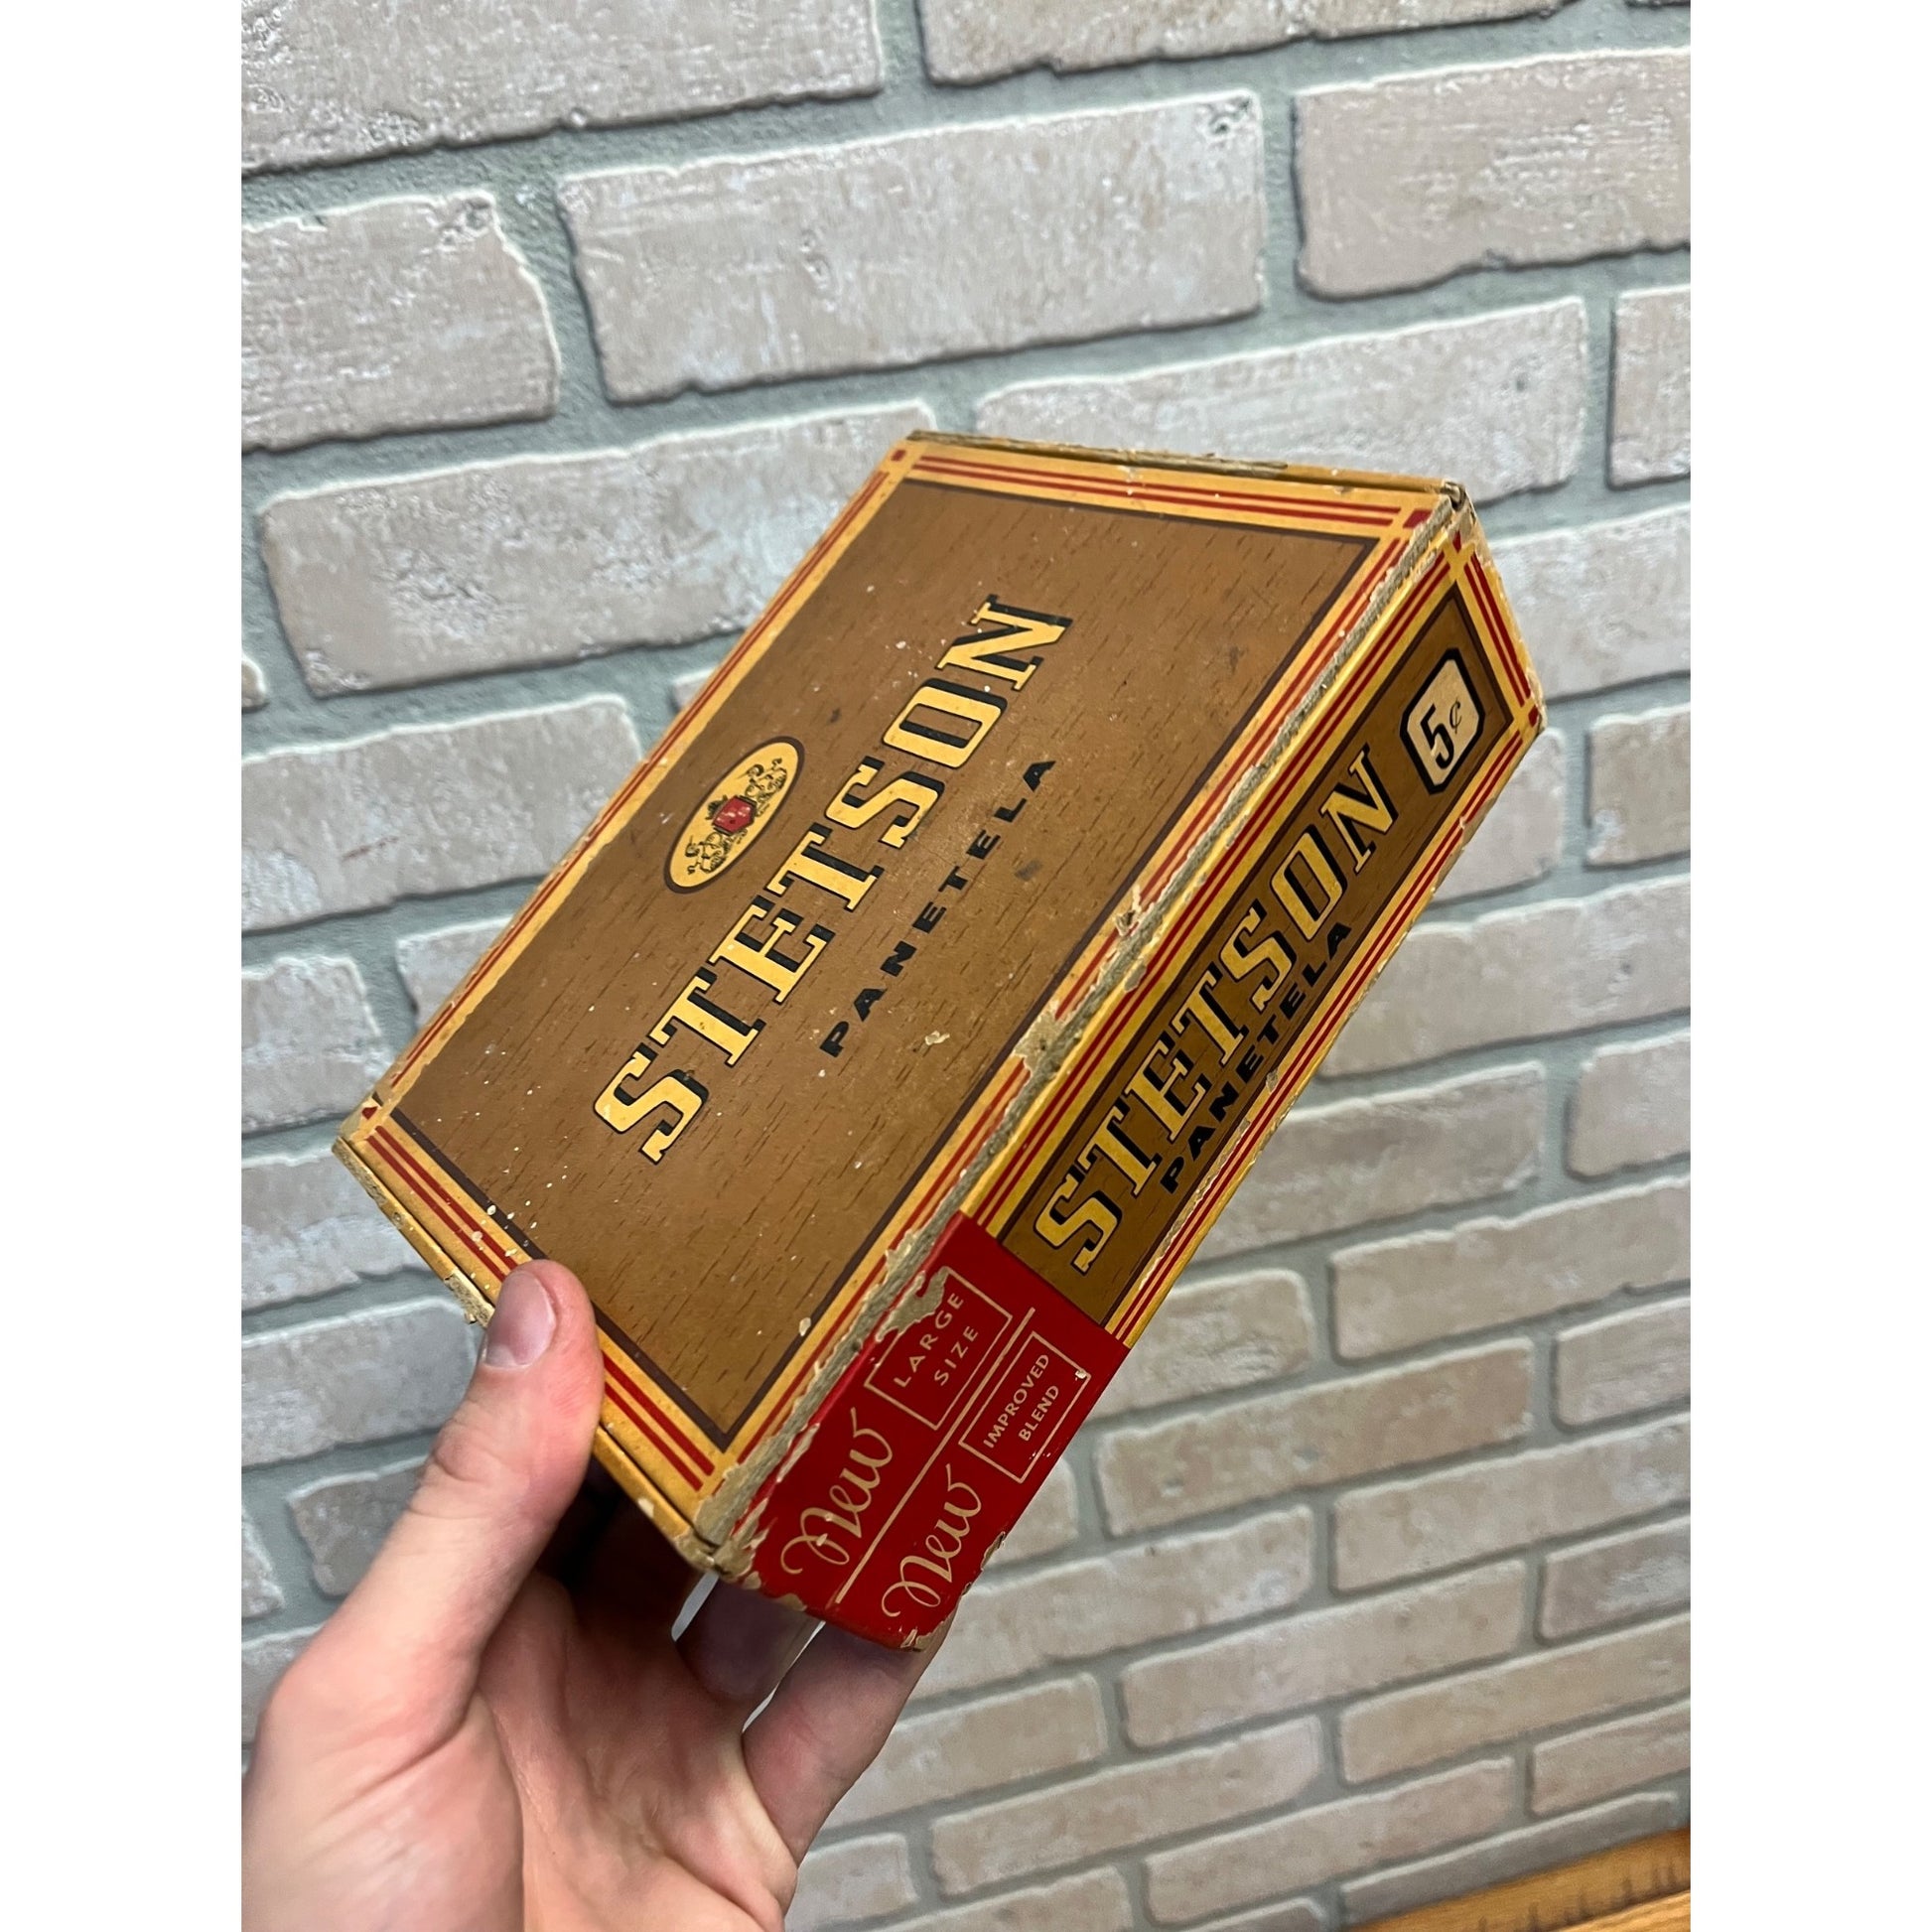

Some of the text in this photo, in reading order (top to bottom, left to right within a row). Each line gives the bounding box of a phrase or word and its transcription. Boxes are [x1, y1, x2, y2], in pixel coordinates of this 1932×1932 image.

[594, 594, 1073, 1164] STETSON
[820, 760, 1055, 1057] PANETELA
[1034, 743, 1399, 1275] STETSON
[1161, 921, 1349, 1194] PANETELA
[894, 1292, 964, 1388] LARGE
[934, 1325, 978, 1386] SIZE
[983, 1353, 1050, 1449] IMPROVED
[1018, 1384, 1059, 1442] BLEND
[780, 1407, 893, 1575] New
[882, 1463, 982, 1617] New
